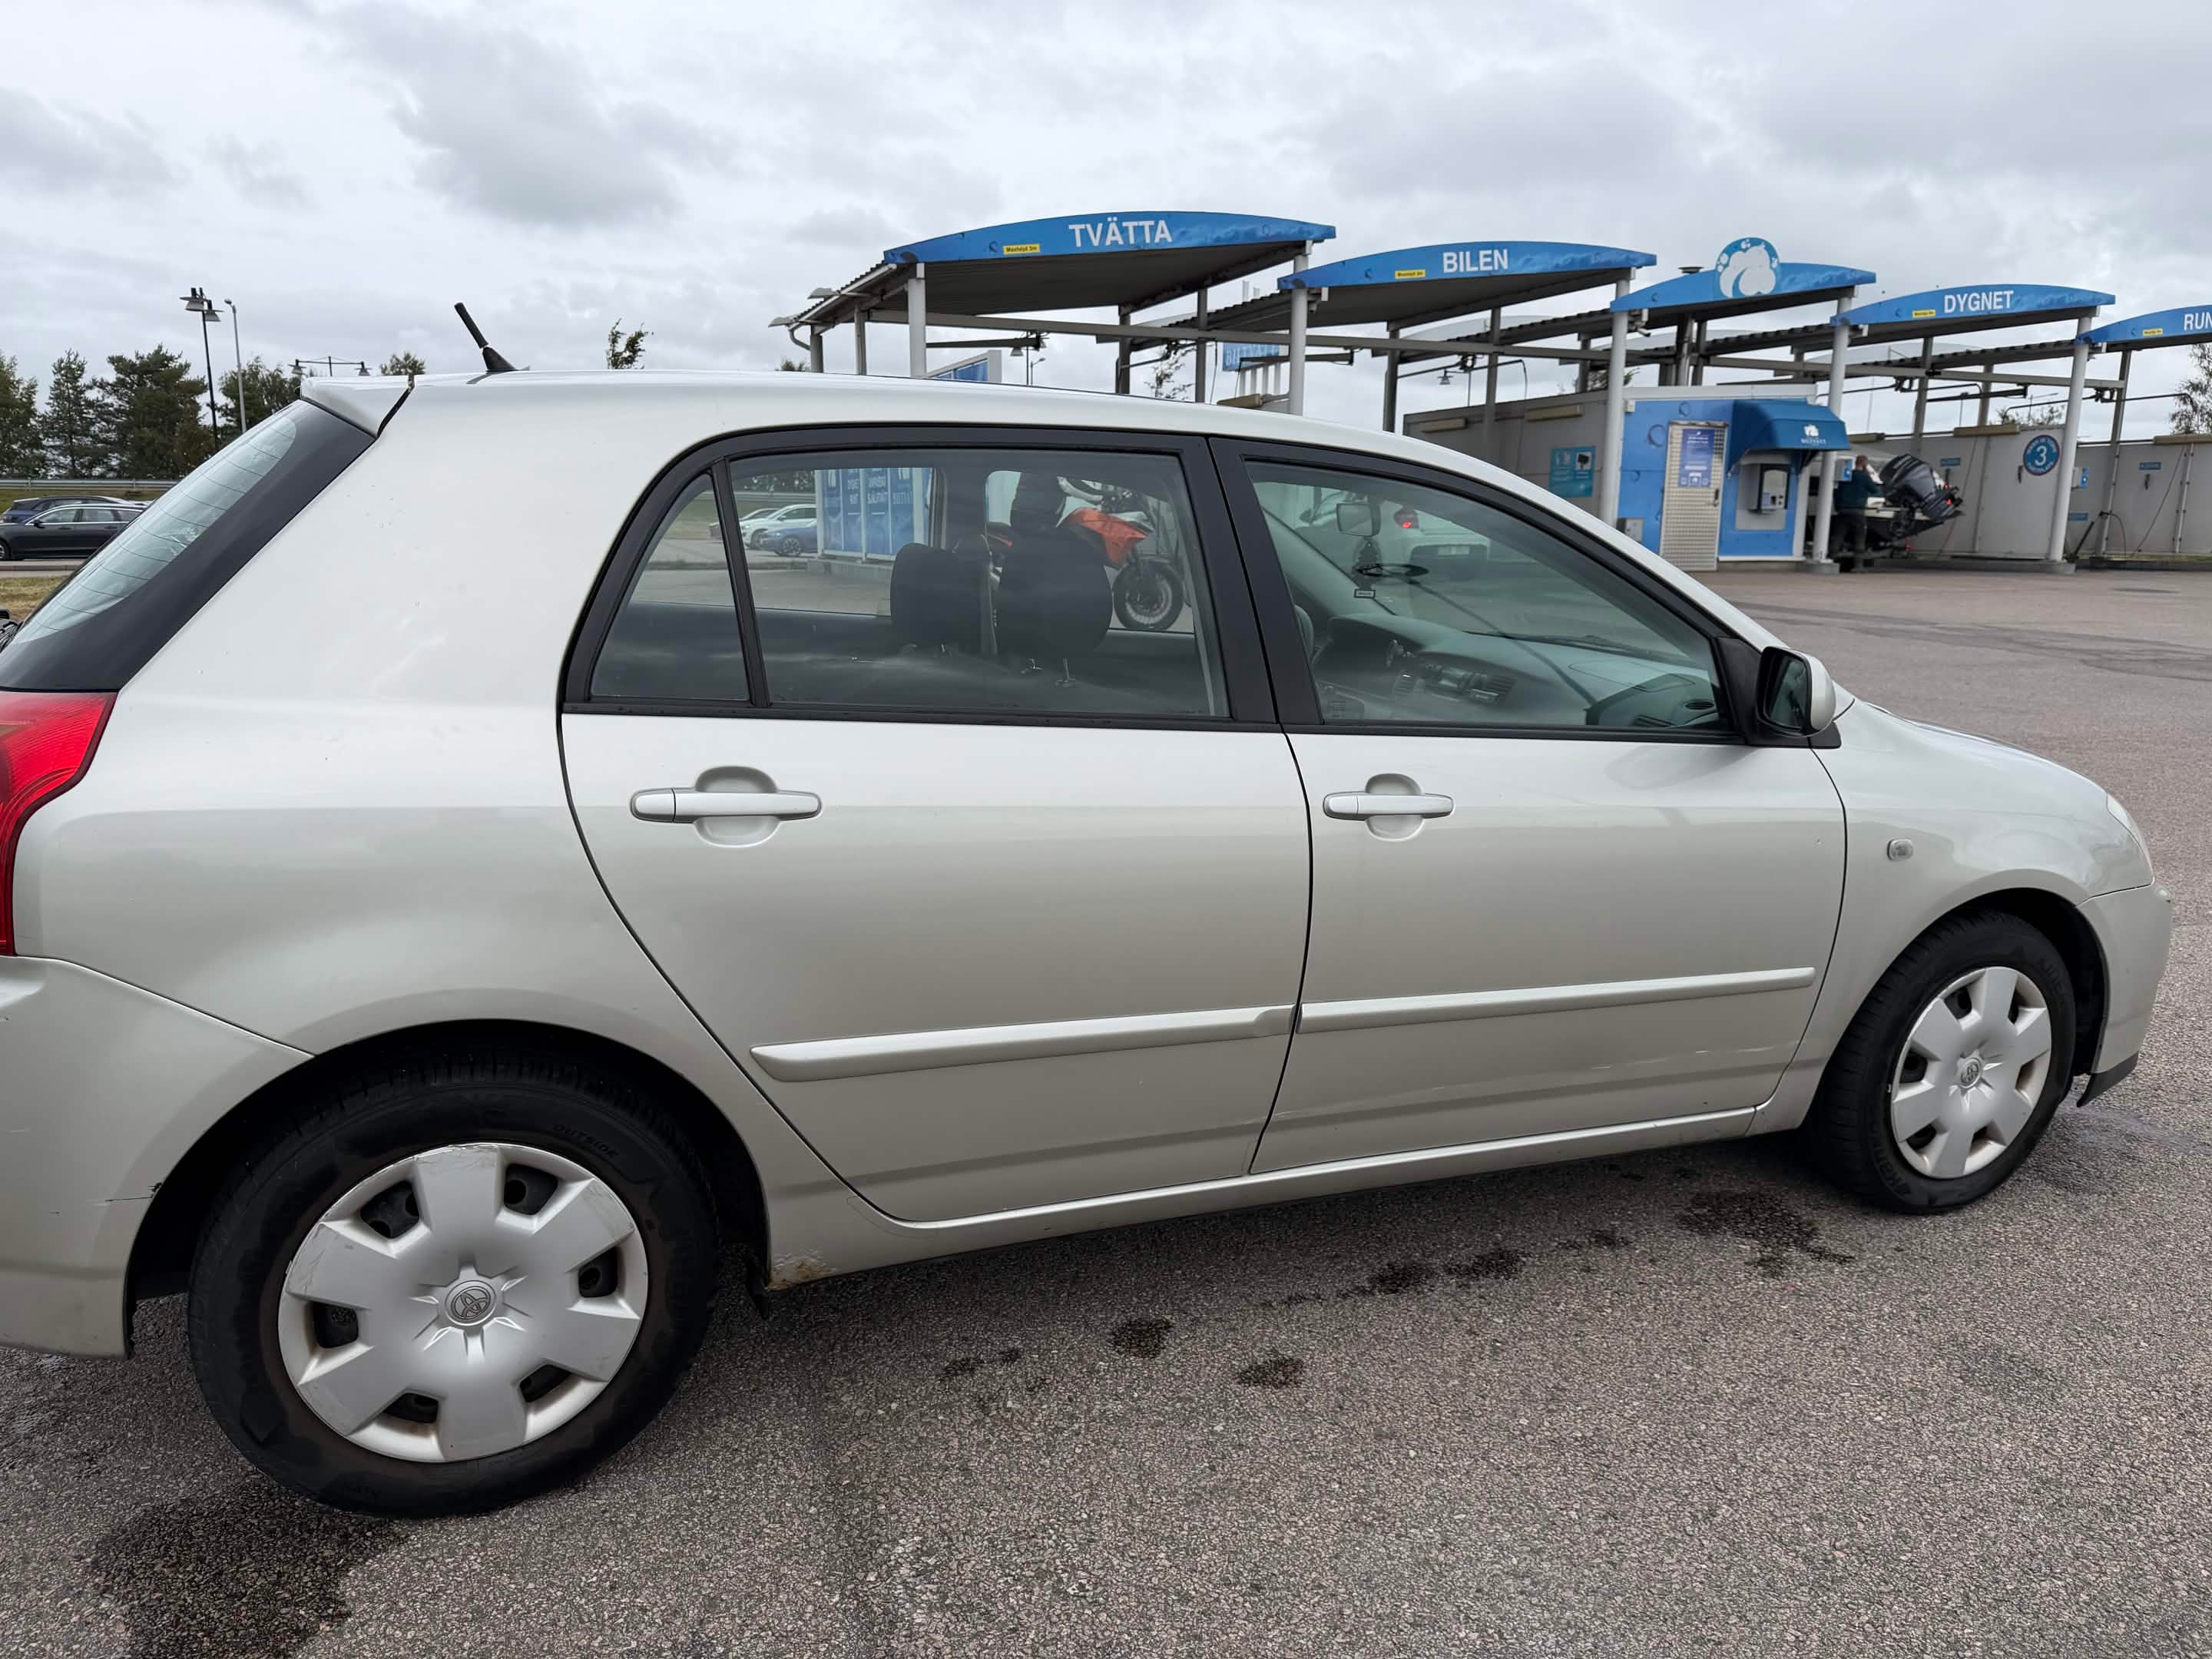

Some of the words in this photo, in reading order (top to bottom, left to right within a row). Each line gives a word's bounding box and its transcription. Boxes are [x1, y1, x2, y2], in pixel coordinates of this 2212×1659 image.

[1068, 217, 1174, 247] TVÄTTA
[1442, 248, 1509, 273] BILEN
[1944, 290, 2014, 313] DYGNET
[2034, 445, 2047, 466] 3
